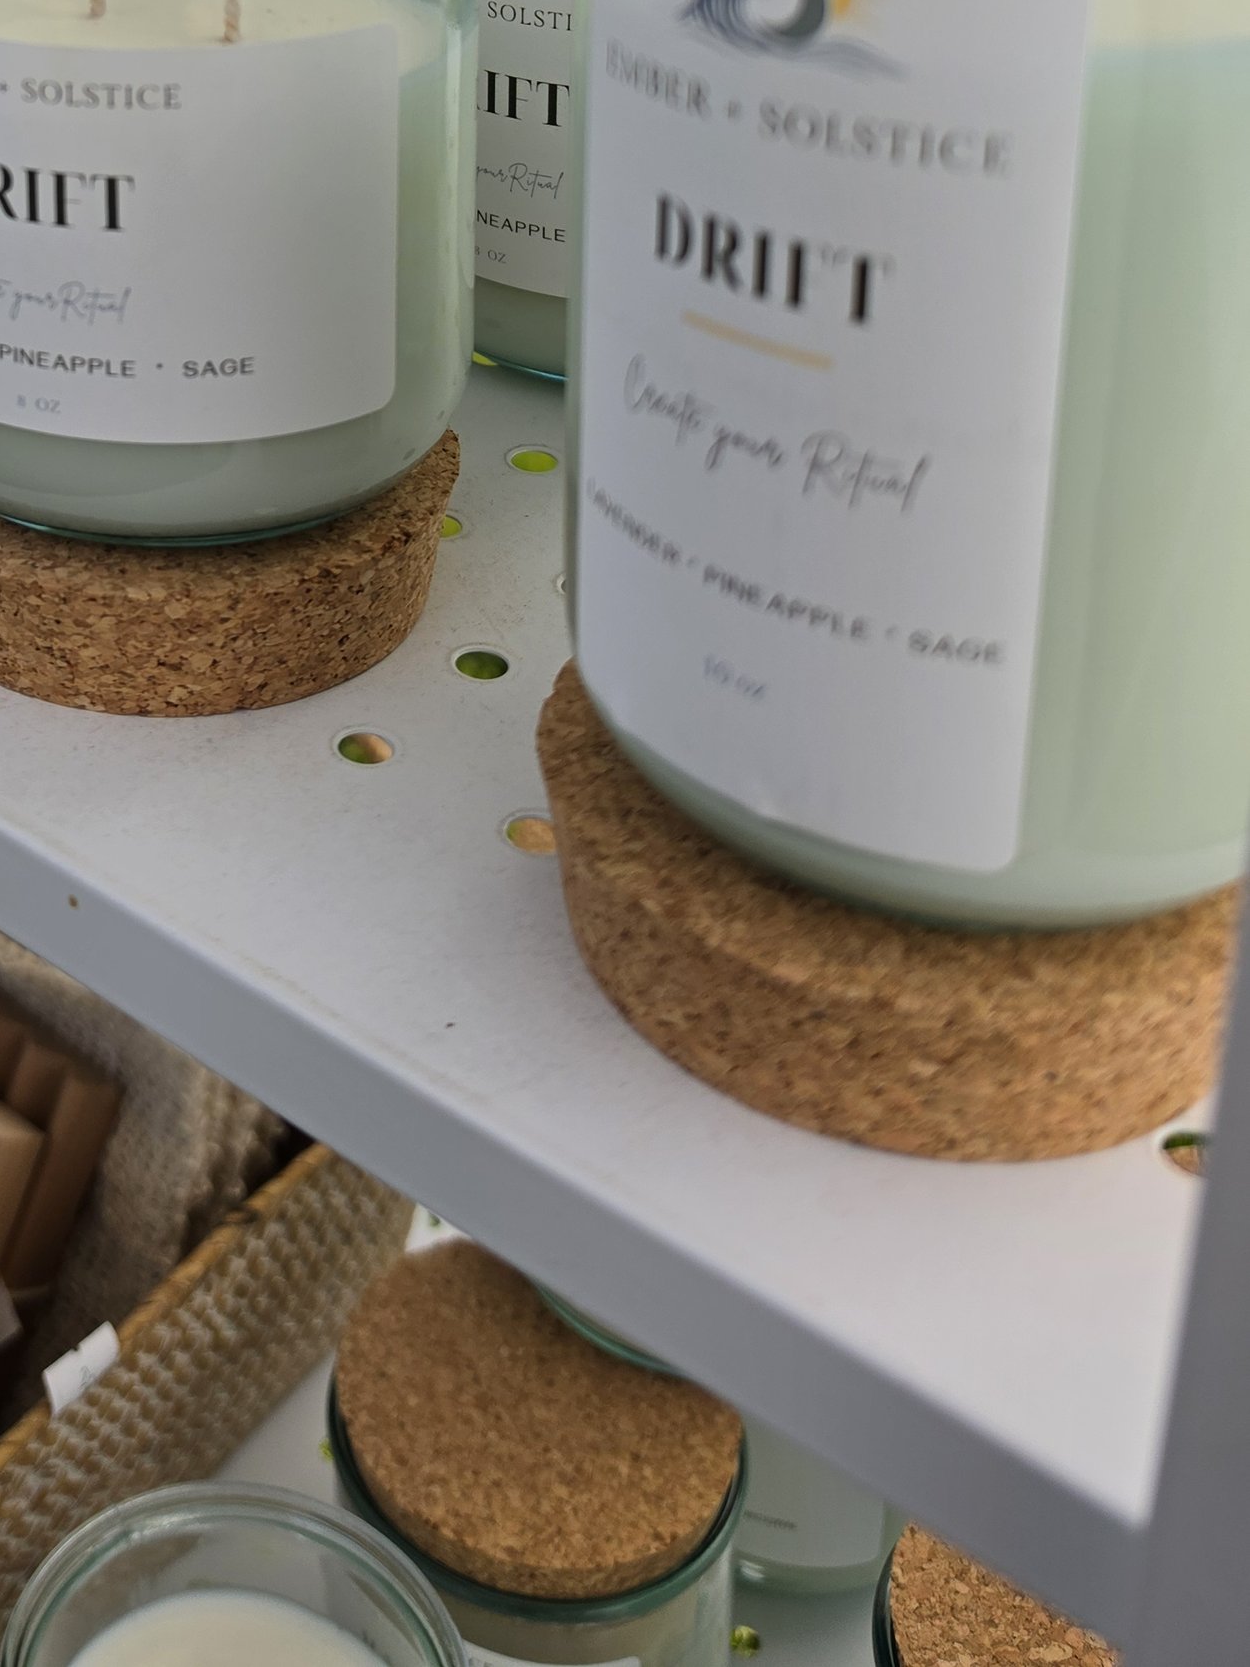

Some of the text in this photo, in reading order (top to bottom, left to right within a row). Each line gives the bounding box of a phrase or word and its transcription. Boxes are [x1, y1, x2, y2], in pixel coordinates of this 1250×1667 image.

[486, 0, 573, 32] SOLSTI
[21, 77, 183, 111] SOLSTICE
[476, 69, 571, 128] IFT
[605, 37, 713, 121] EMBER
[758, 96, 1011, 179] SOLSTICE
[508, 161, 565, 200] Ritual
[476, 209, 567, 244] NEAPPLE
[653, 189, 898, 328] DRIFT
[8, 289, 59, 322] your
[57, 280, 133, 327] Ritual
[182, 355, 256, 380] SAGE
[622, 351, 932, 515] Create your Ritual
[701, 561, 871, 638] PINEAPPLE
[906, 629, 1003, 667] SAGE
